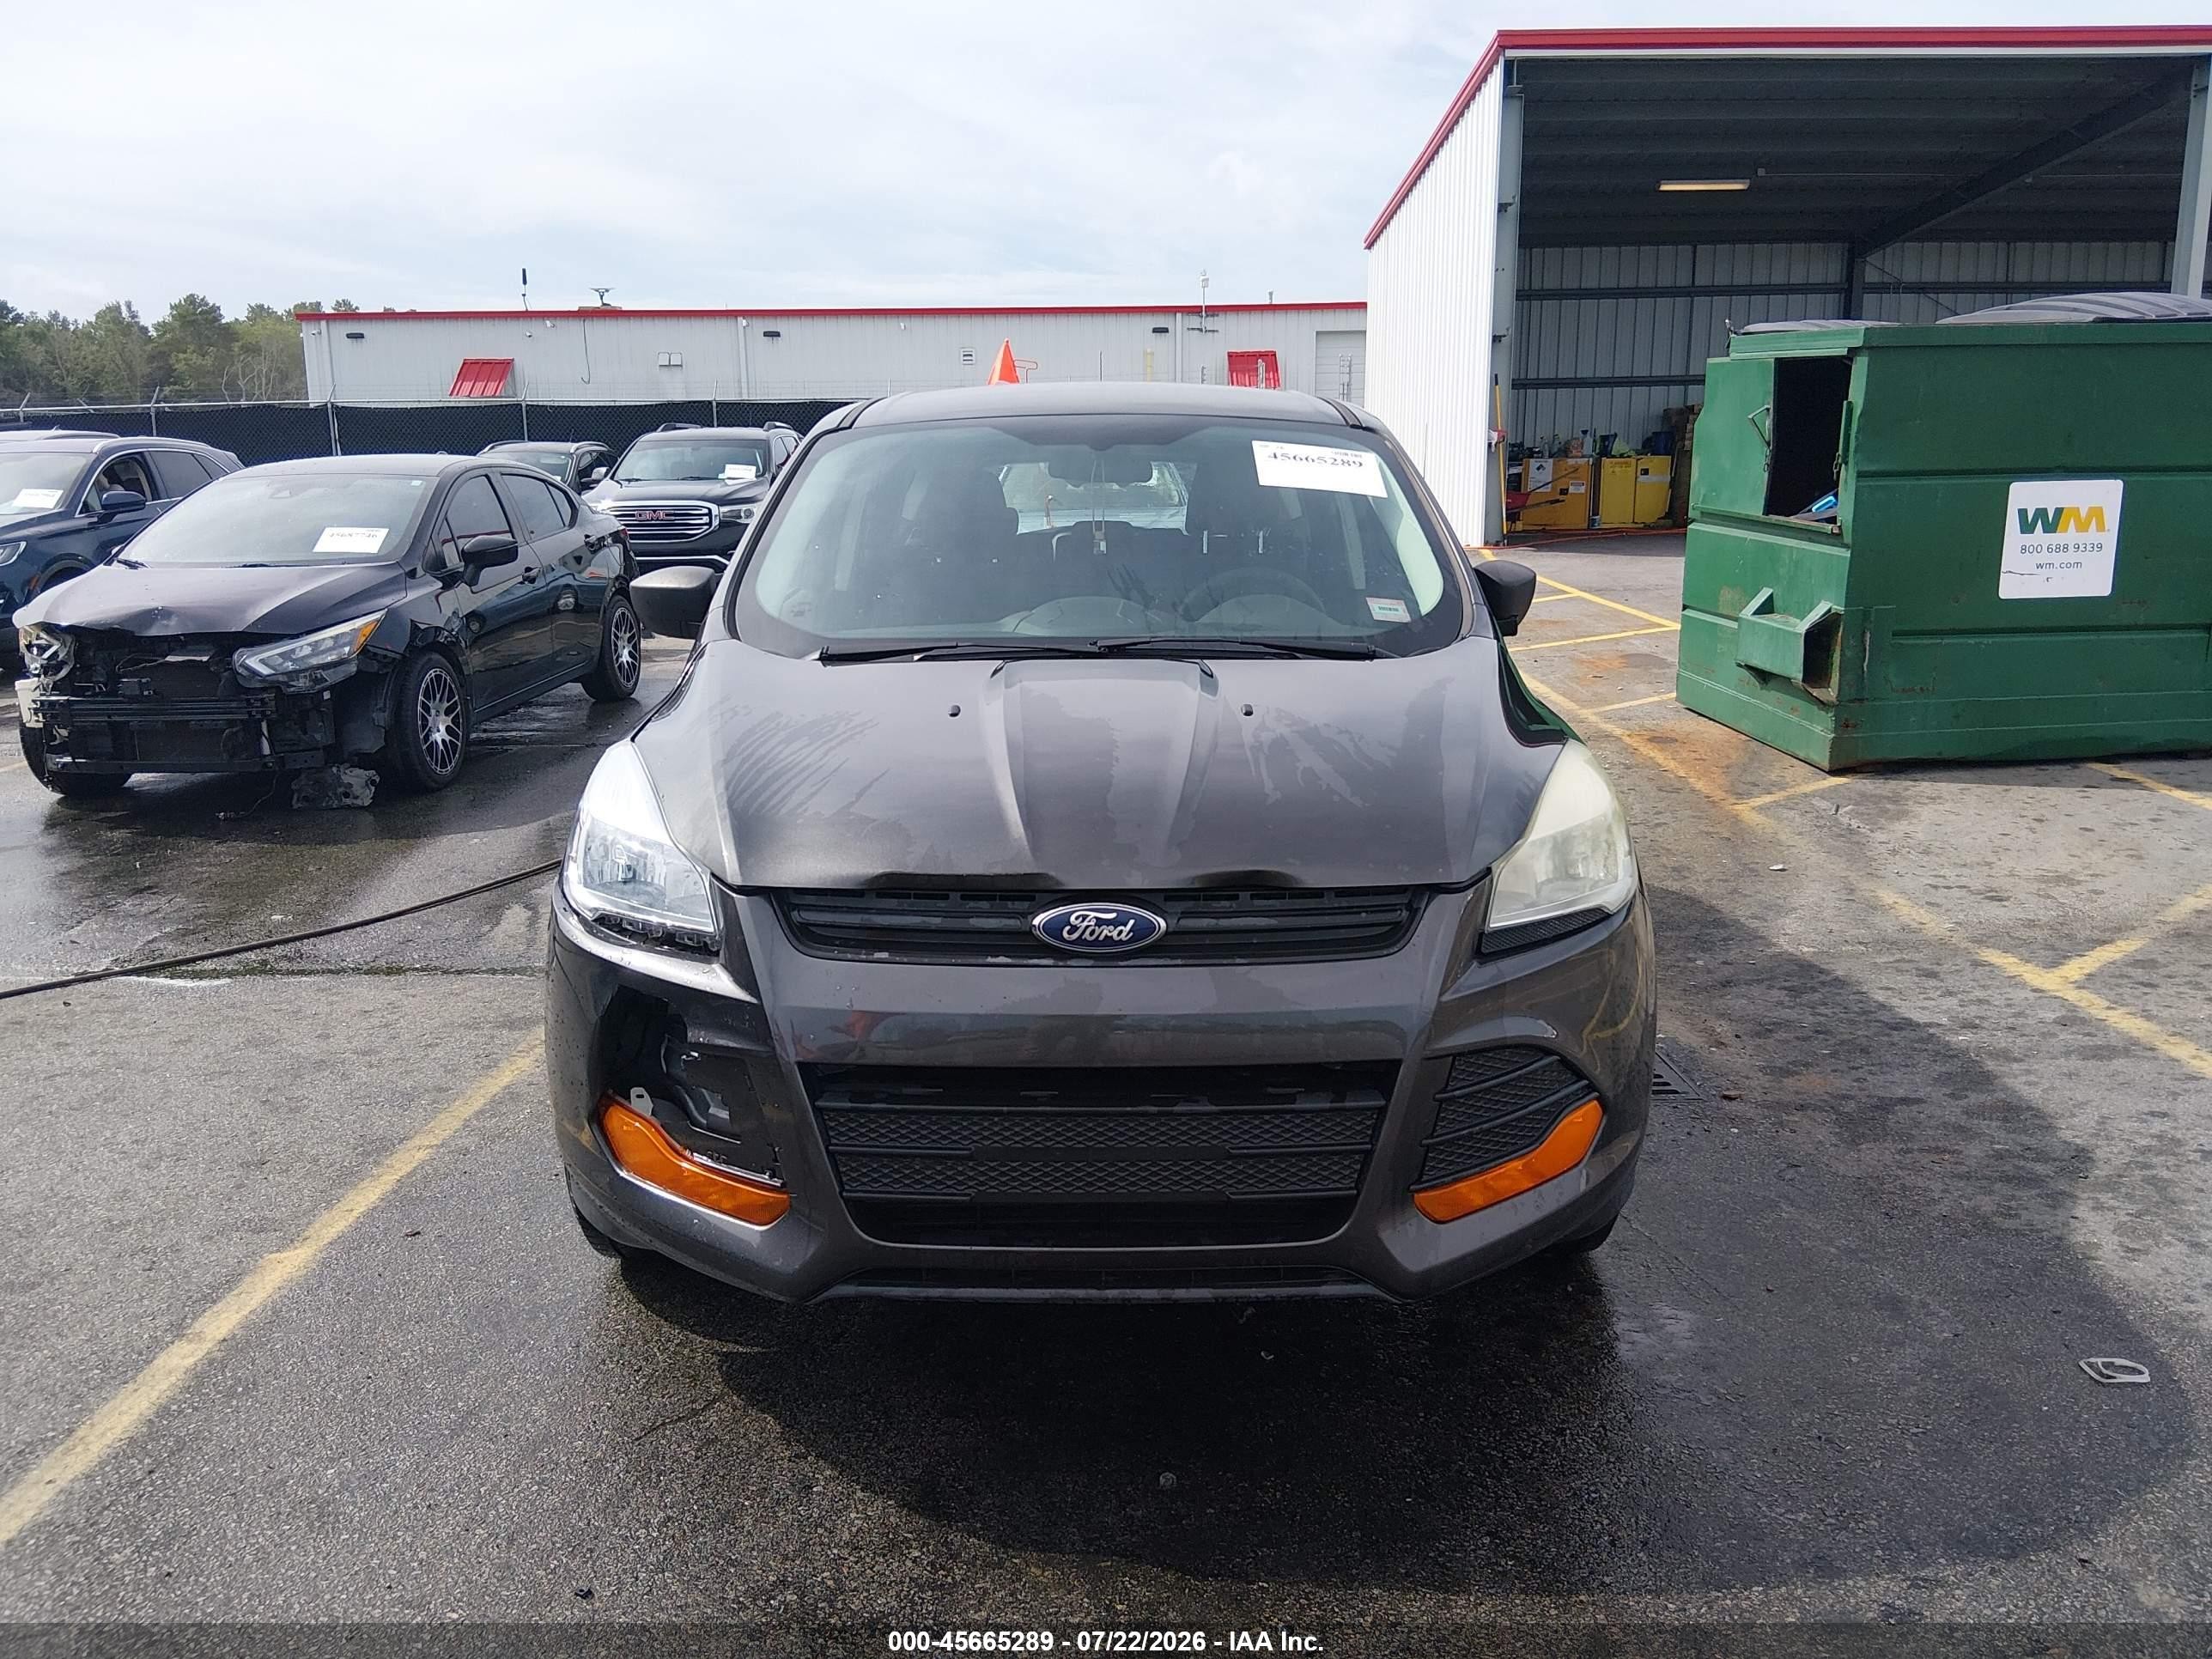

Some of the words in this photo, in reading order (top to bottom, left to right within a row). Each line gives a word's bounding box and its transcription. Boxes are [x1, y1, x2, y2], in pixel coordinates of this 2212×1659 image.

[1267, 452, 1364, 468] 45665289
[635, 510, 676, 520] GMC
[2017, 506, 2106, 534] WM
[2020, 544, 2043, 555] 800
[2046, 543, 2069, 554] 688
[2073, 542, 2103, 553] 9339
[2035, 561, 2082, 570] wm.com
[1062, 910, 1136, 941] Ford
